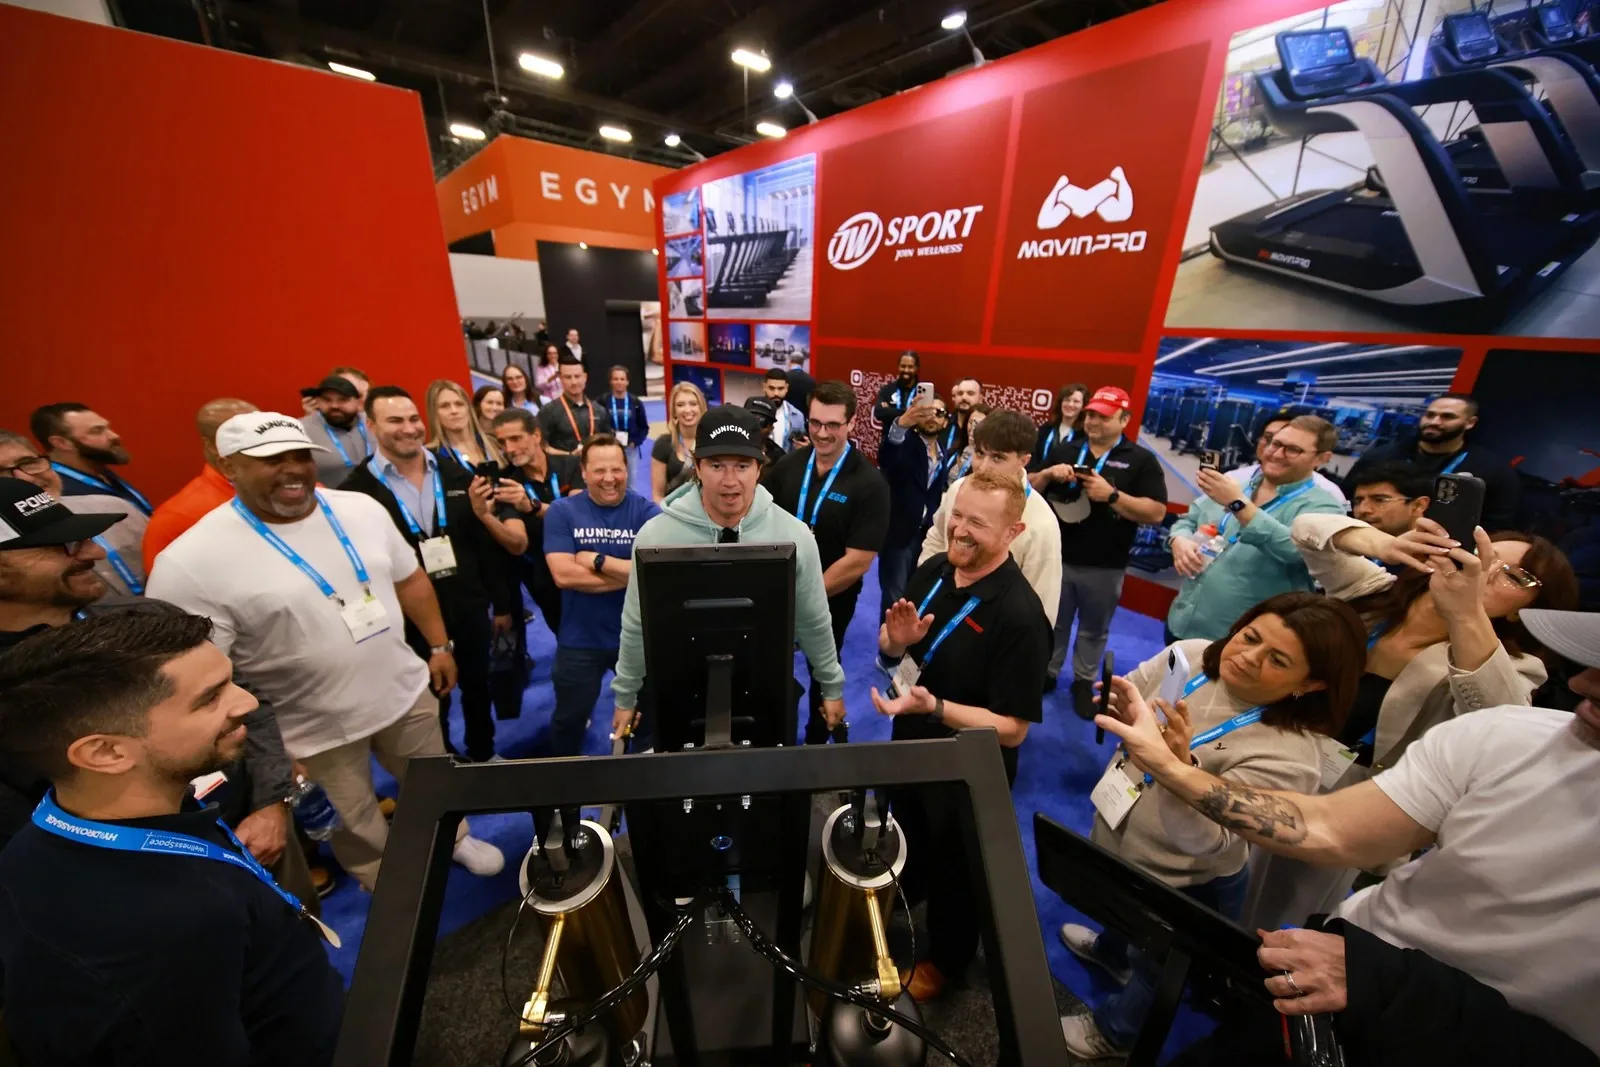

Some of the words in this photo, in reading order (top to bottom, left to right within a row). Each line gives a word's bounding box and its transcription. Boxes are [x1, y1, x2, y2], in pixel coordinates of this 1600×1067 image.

[461, 174, 499, 215] EGYM
[885, 205, 984, 246] SPORT
[894, 249, 914, 261] JOIN
[917, 243, 963, 256] WELLNESS
[710, 424, 750, 440] MUNICIPAL
[573, 527, 637, 539] MUNICIPAL
[45, 814, 118, 842] HYDROMASSAGE
[149, 838, 205, 855] WellnessSpace
